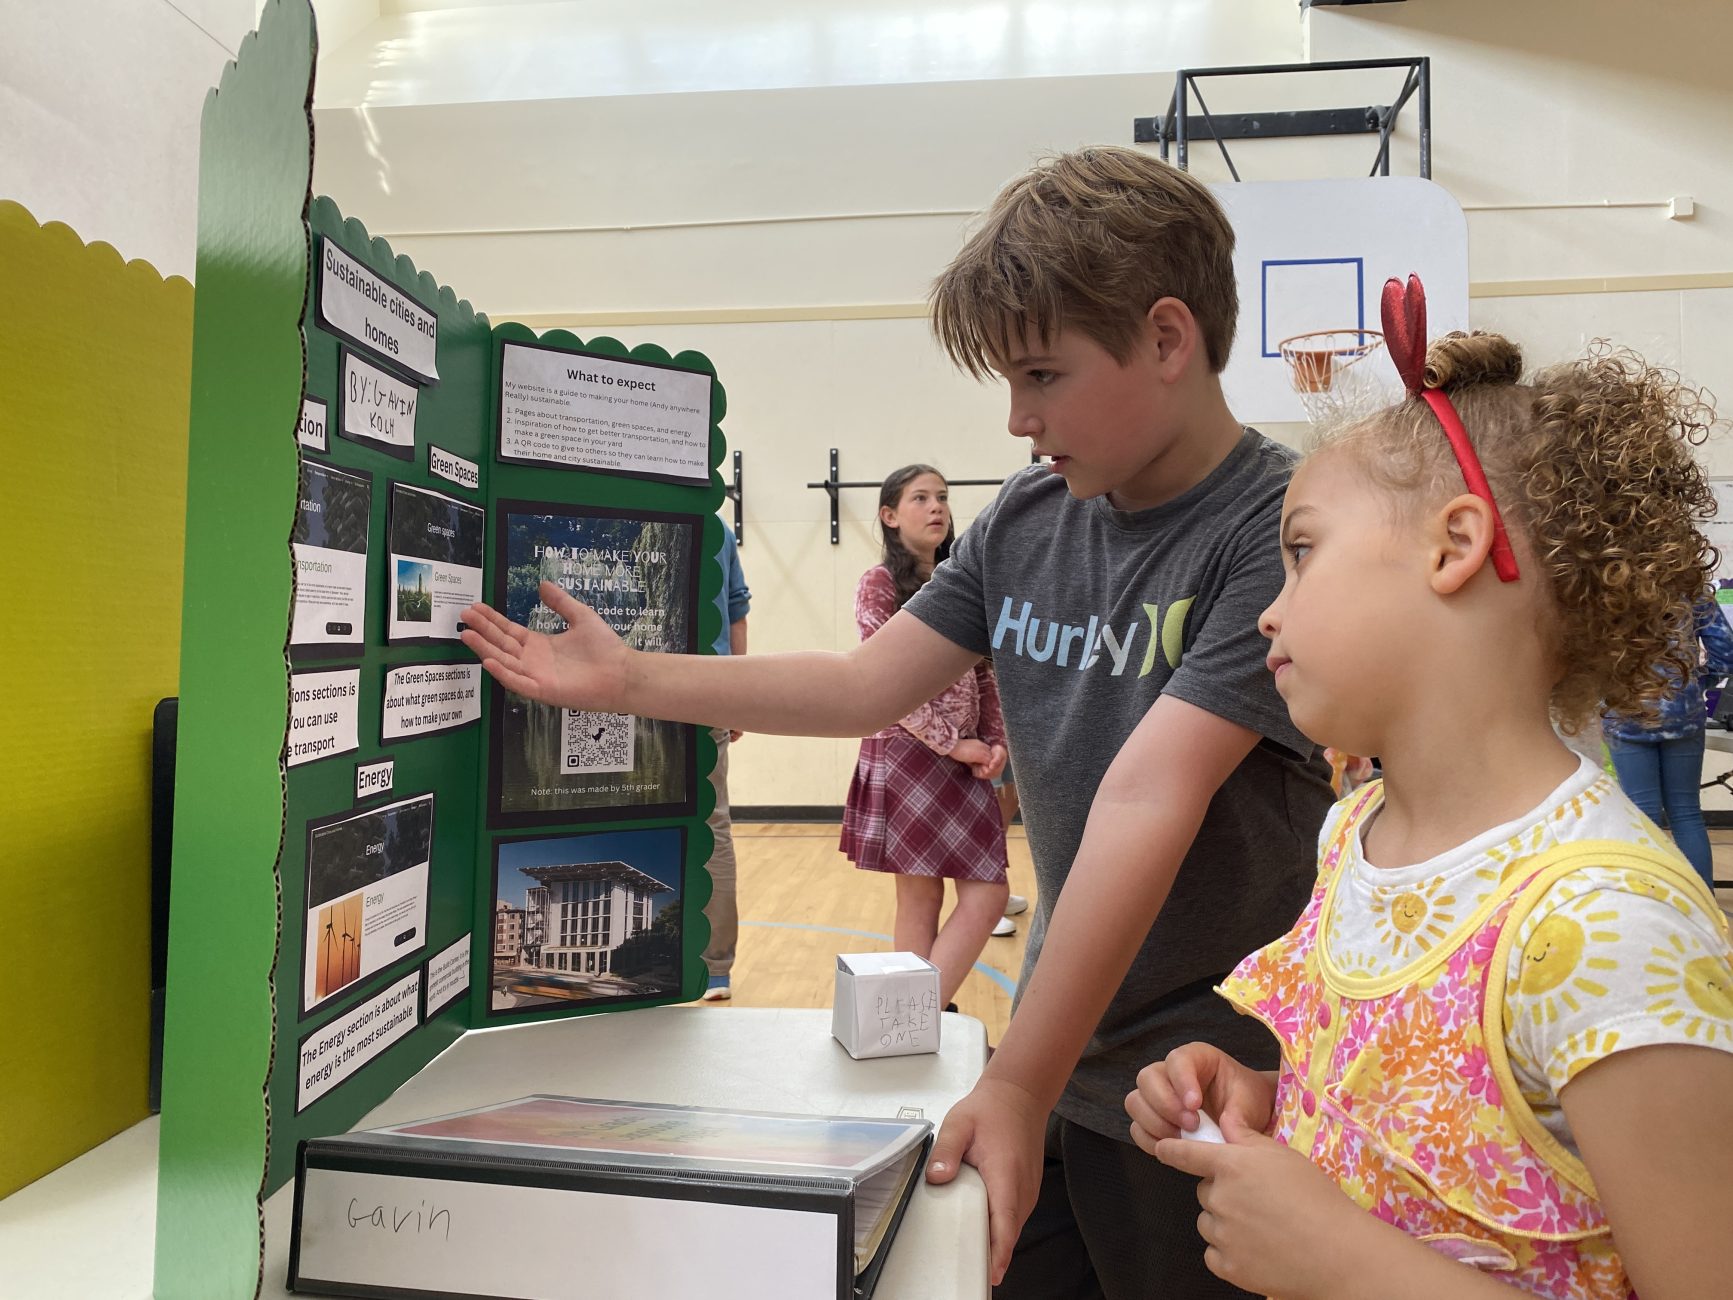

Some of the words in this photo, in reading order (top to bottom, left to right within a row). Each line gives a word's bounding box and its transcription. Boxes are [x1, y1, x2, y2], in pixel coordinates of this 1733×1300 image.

[325, 248, 387, 309] Sustainable
[389, 297, 415, 327] cities
[417, 318, 435, 340] and
[365, 317, 399, 355] homes
[567, 369, 599, 383] What
[601, 374, 614, 385] to
[617, 378, 656, 391] expect
[505, 381, 516, 390] My
[517, 384, 545, 393] website
[559, 389, 578, 397] guide
[588, 393, 613, 403] making
[630, 398, 648, 407] home
[670, 405, 700, 414] anywhere
[514, 408, 535, 418] Pages
[537, 411, 557, 420] about
[559, 414, 610, 427] transportation,
[611, 421, 631, 429] green
[632, 424, 656, 433] spaces,
[670, 430, 692, 438] energy
[514, 418, 553, 429] Inspiration
[562, 424, 577, 432] how
[587, 428, 598, 436] get
[599, 429, 620, 438] better
[622, 432, 671, 445] transportation,
[671, 438, 683, 446] and
[684, 439, 698, 447] how
[514, 429, 533, 437] make
[540, 432, 560, 440] green
[561, 435, 582, 443] space
[590, 438, 606, 446] your
[608, 440, 623, 448] yard
[520, 439, 532, 447] QR
[533, 441, 551, 449] code
[561, 445, 575, 453] give
[585, 447, 607, 456] others
[617, 451, 633, 459] they
[664, 456, 678, 464] how
[688, 459, 705, 467] make
[533, 450, 552, 459] home
[554, 453, 567, 461] and
[431, 452, 453, 475] Green
[454, 463, 478, 484] Spaces
[427, 522, 441, 534] Green
[442, 528, 456, 538] spaces
[534, 545, 564, 559] HOW
[571, 547, 589, 560] TO
[593, 549, 629, 562] MAKE
[633, 550, 667, 564] YOUR
[434, 571, 447, 582] Green
[448, 573, 462, 584] Spaces
[563, 561, 601, 576] HOME
[605, 565, 641, 578] MORE
[558, 577, 645, 593] SUSTAINABLE
[597, 606, 623, 615] code
[625, 606, 636, 616] to
[639, 606, 665, 617] learn
[536, 620, 560, 629] how
[634, 621, 662, 631] home
[634, 637, 642, 646] It
[394, 672, 404, 685] The
[405, 672, 424, 684] Green
[424, 670, 445, 685] Spaces
[445, 668, 466, 680] sections
[466, 668, 470, 679] is
[312, 684, 347, 700] sections
[348, 682, 356, 696] is
[386, 694, 404, 709] about
[405, 693, 420, 706] what
[421, 693, 438, 707] green
[438, 690, 456, 704] spaces
[465, 686, 474, 698] and
[307, 714, 322, 727] can
[324, 712, 338, 725] use
[401, 715, 413, 729] how
[415, 715, 422, 726] to
[422, 711, 437, 725] make
[438, 711, 451, 725] your
[451, 710, 463, 720] own
[294, 736, 335, 755] transport
[358, 766, 392, 790] Energy
[531, 788, 553, 796] Note:
[554, 786, 569, 795] this
[587, 785, 609, 793] made
[610, 785, 620, 793] by
[621, 783, 635, 792] 5th
[635, 783, 660, 792] grader
[366, 840, 385, 856] Energy
[366, 892, 385, 907] Energy
[302, 1050, 317, 1067] The
[319, 1029, 346, 1056] Energy
[346, 1010, 374, 1036] section
[374, 1004, 381, 1018] is
[381, 991, 401, 1013] about
[401, 981, 418, 1000] what
[880, 1012, 929, 1031] TAKE
[305, 1061, 334, 1090] energy
[334, 1054, 341, 1069] is
[343, 1046, 355, 1062] the
[356, 1031, 375, 1053] most
[375, 1005, 413, 1039] sustainable
[880, 1029, 921, 1048] ONE
[347, 1197, 450, 1242] Gavin
